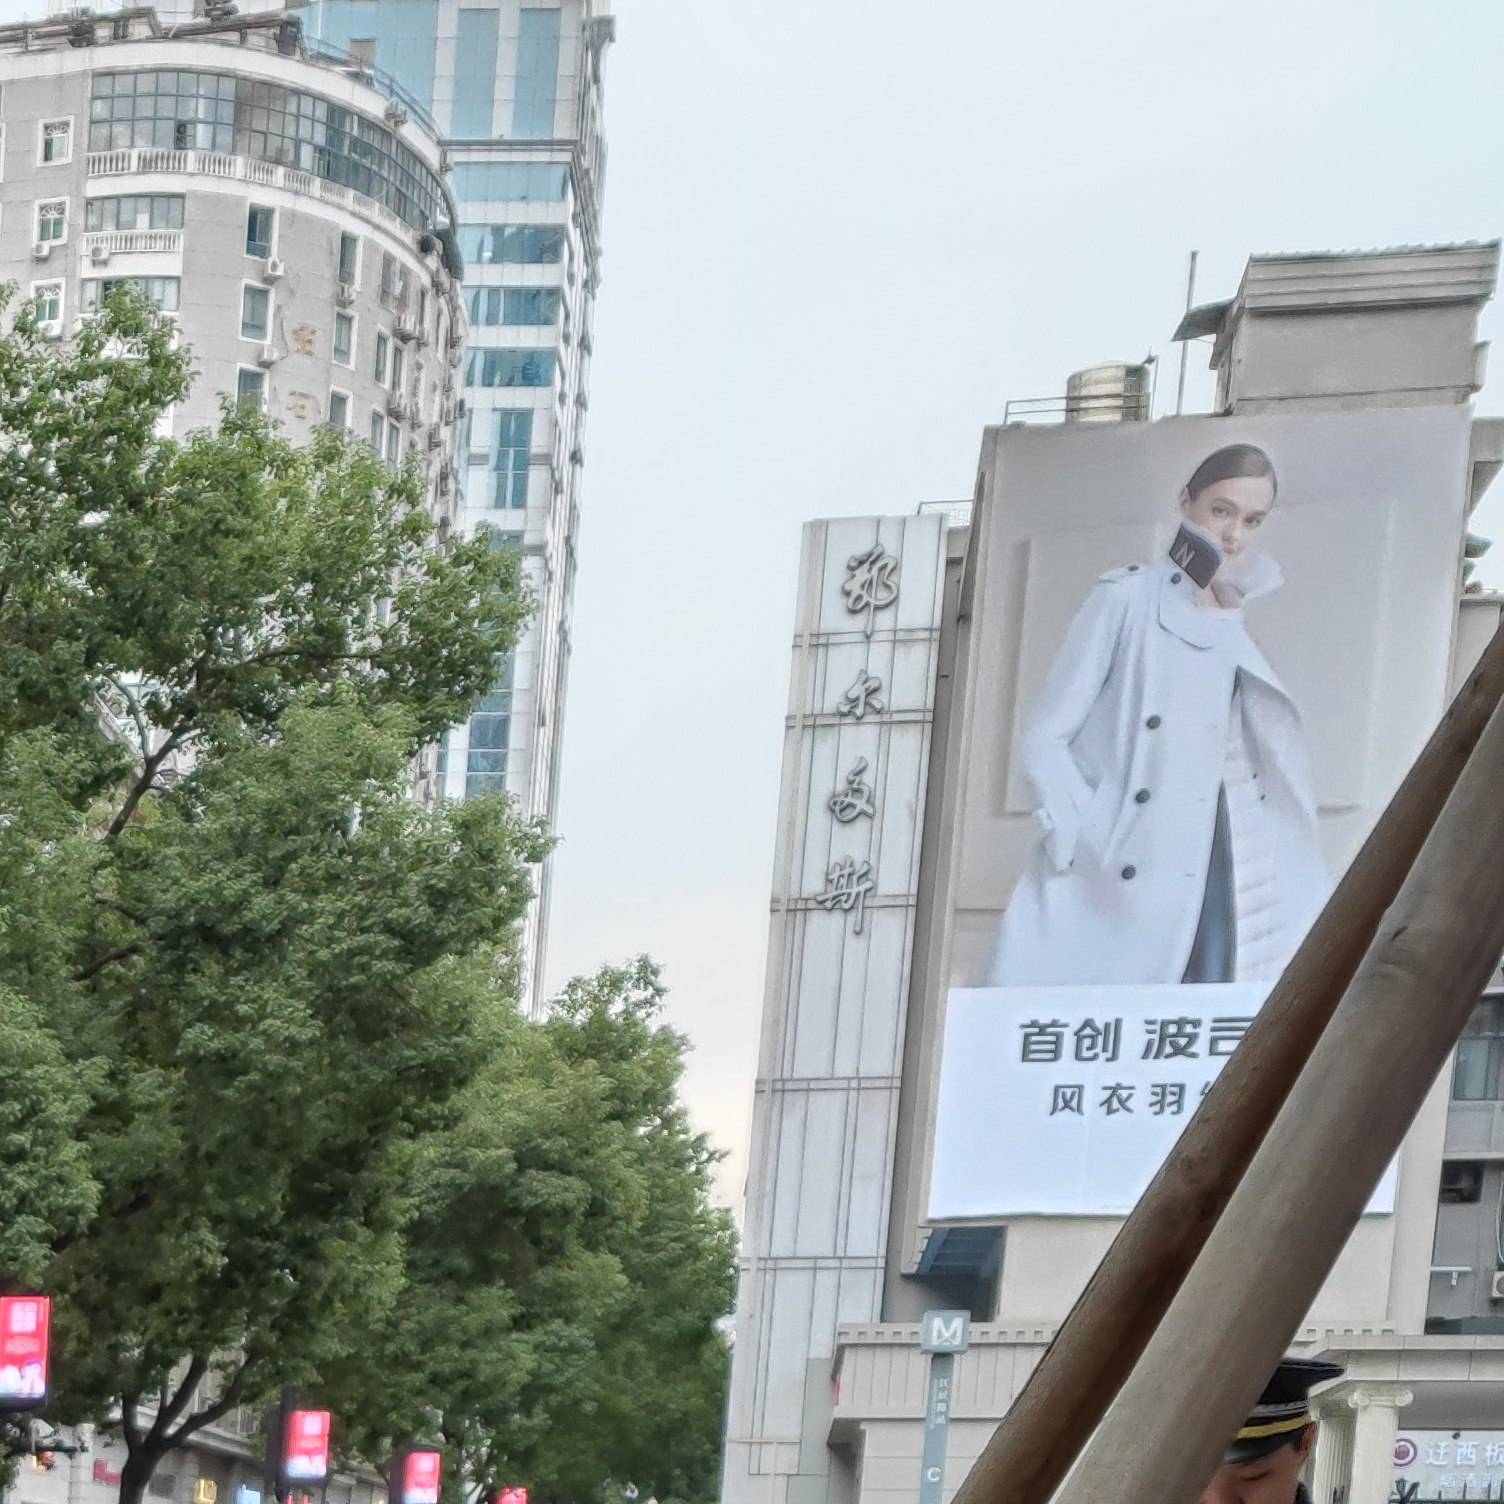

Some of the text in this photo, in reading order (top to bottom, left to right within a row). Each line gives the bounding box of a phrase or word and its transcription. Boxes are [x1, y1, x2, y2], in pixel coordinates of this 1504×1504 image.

[815, 543, 901, 936] 鄂尔多斯
[1019, 1017, 1123, 1063] 首创
[1049, 1080, 1214, 1116] 风衣羽
[927, 1466, 942, 1483] C
